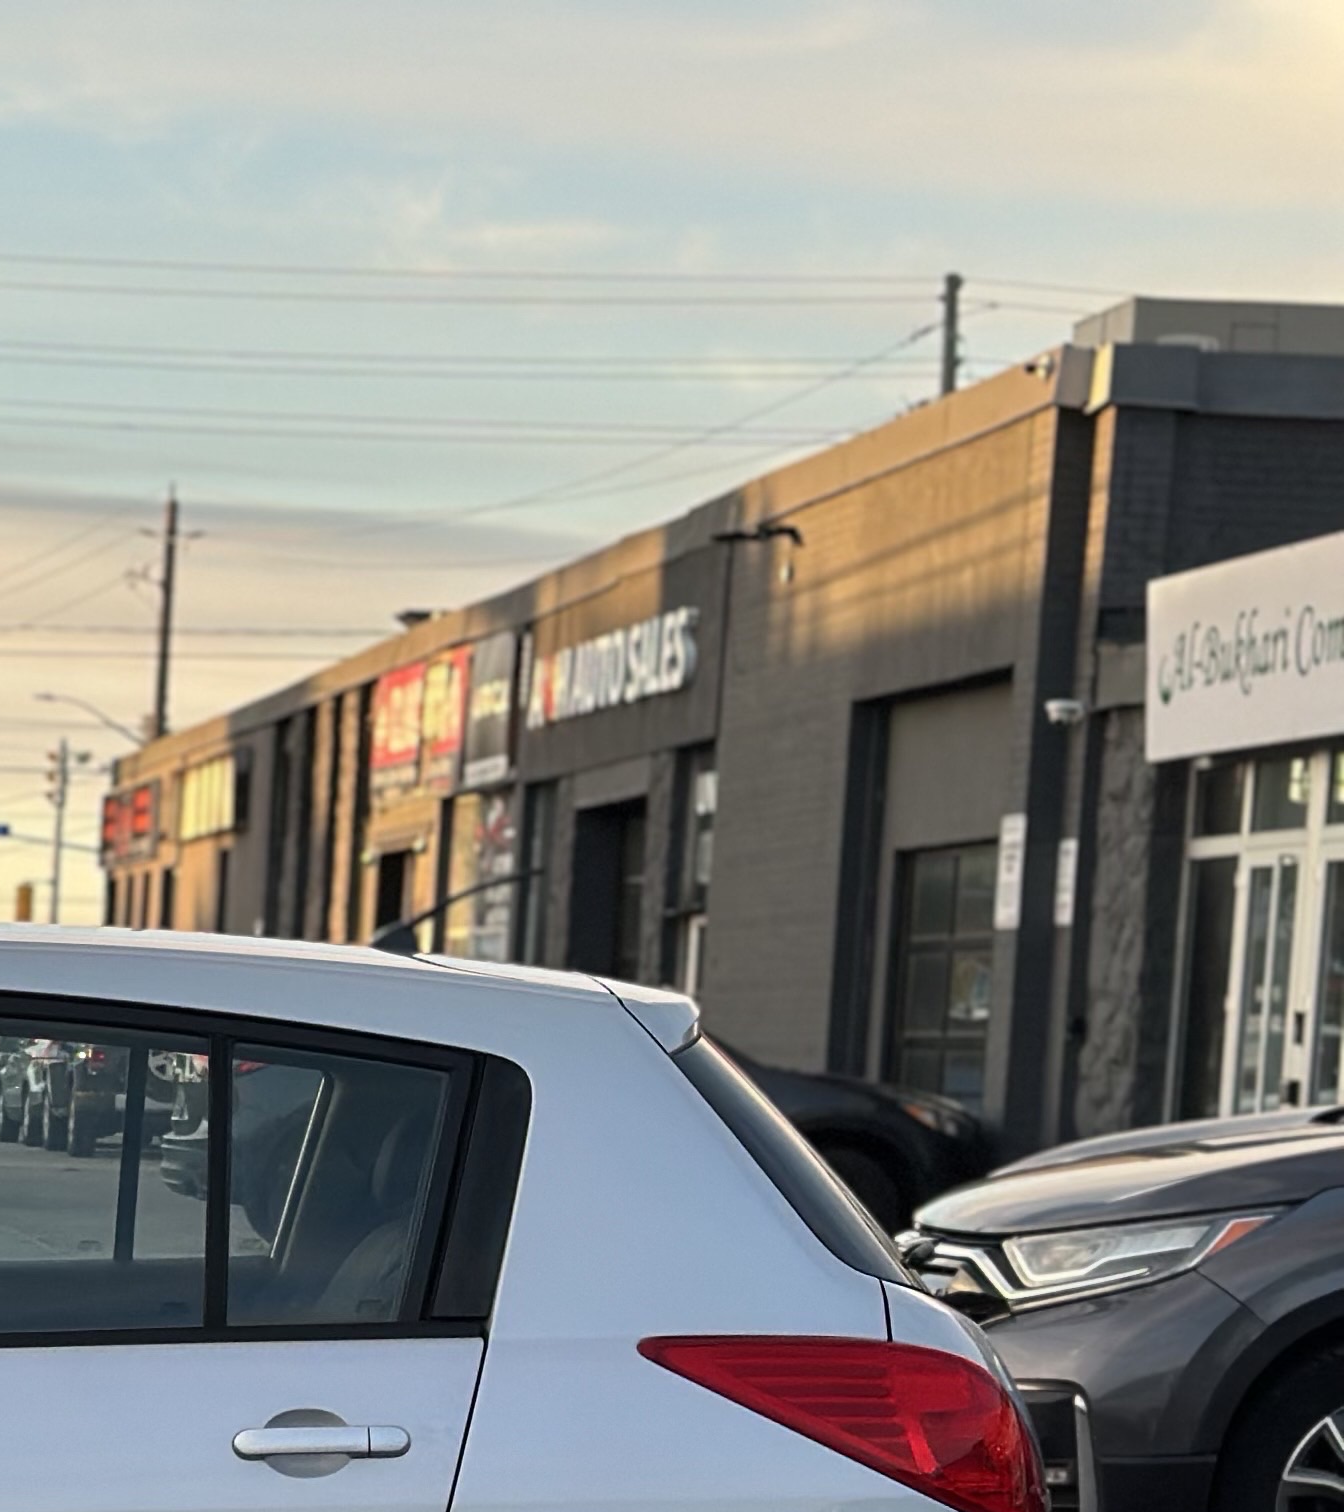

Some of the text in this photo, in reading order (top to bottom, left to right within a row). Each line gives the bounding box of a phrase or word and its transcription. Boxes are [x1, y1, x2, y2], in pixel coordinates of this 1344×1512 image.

[571, 630, 625, 715] AUTO
[625, 606, 687, 703] SALES
[1159, 607, 1291, 705] Al-Bukhari
